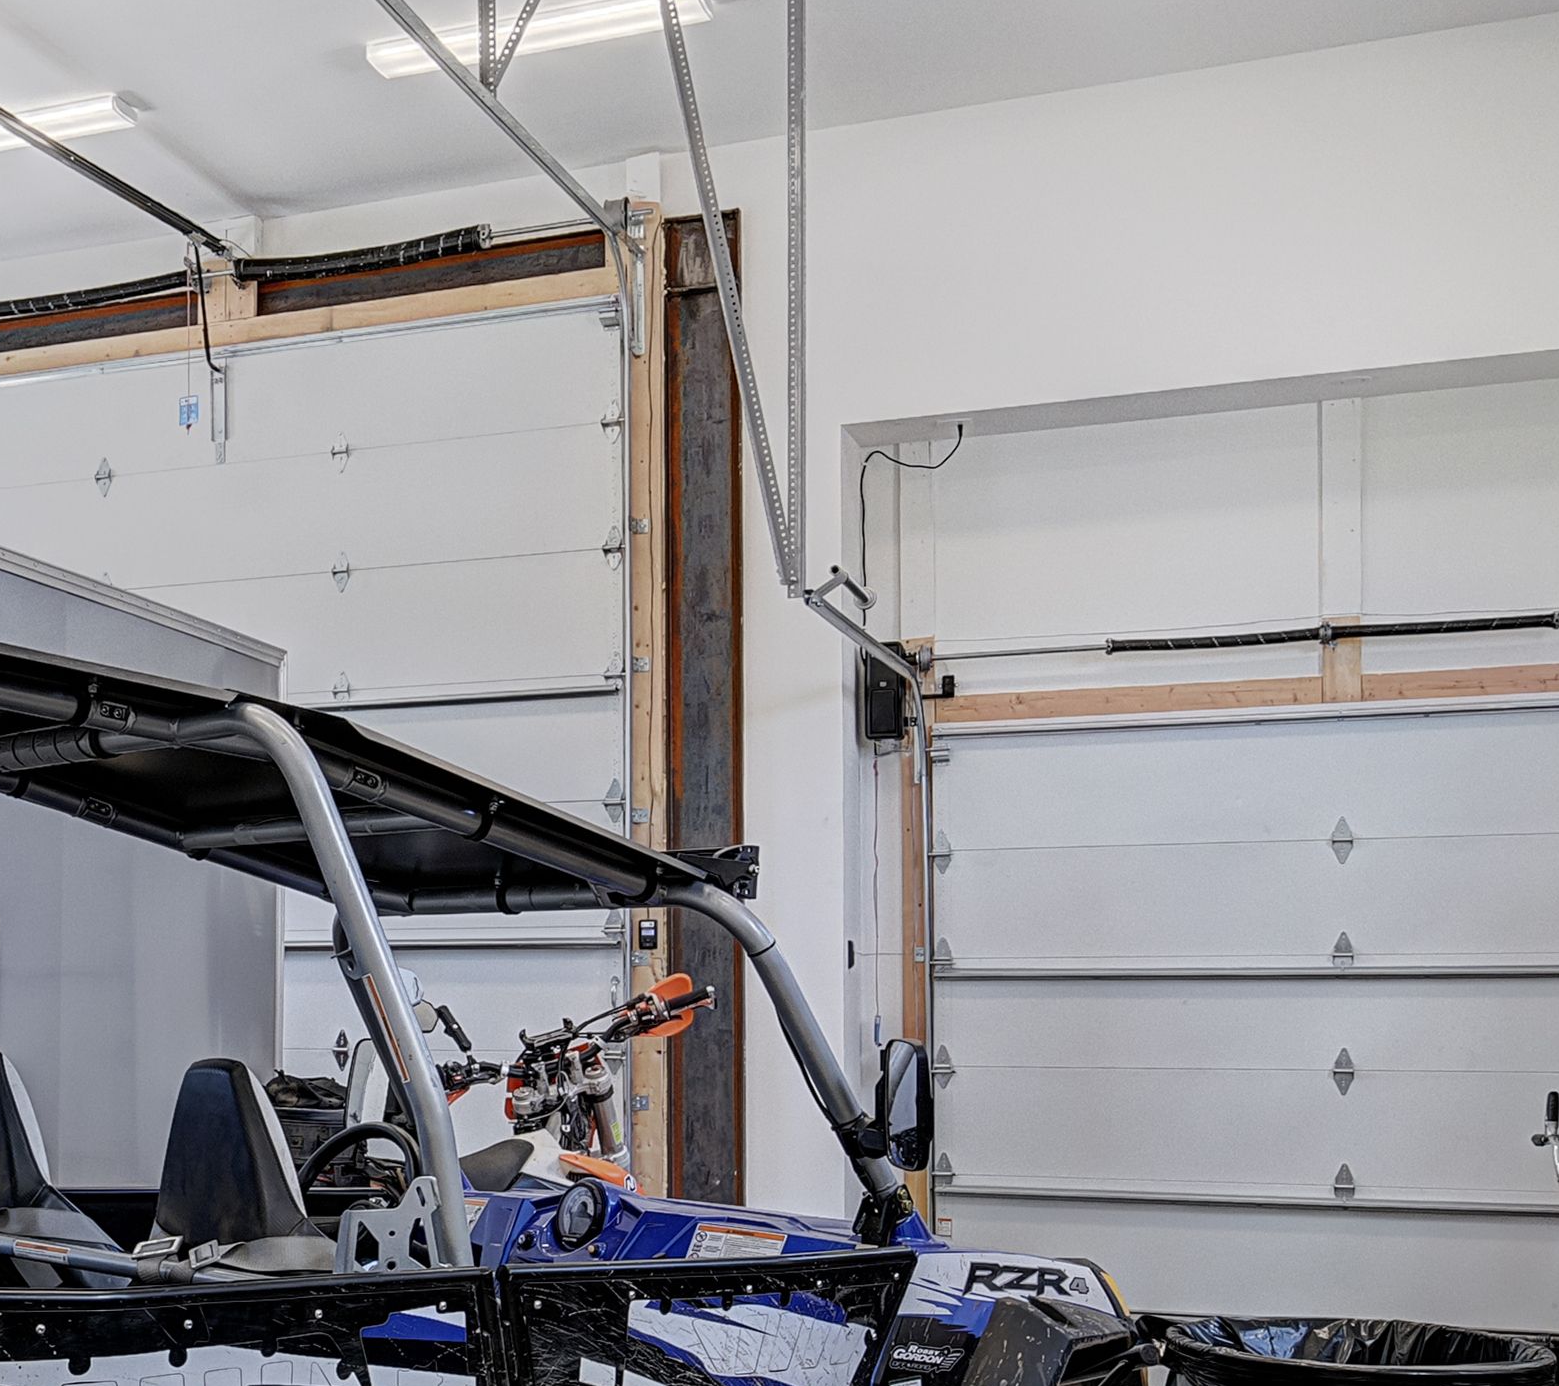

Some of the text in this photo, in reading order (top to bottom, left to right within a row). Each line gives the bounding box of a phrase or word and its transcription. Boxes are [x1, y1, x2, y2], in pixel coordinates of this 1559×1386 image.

[962, 1261, 1090, 1297] RZR 4
[893, 1348, 944, 1364] GORDON
